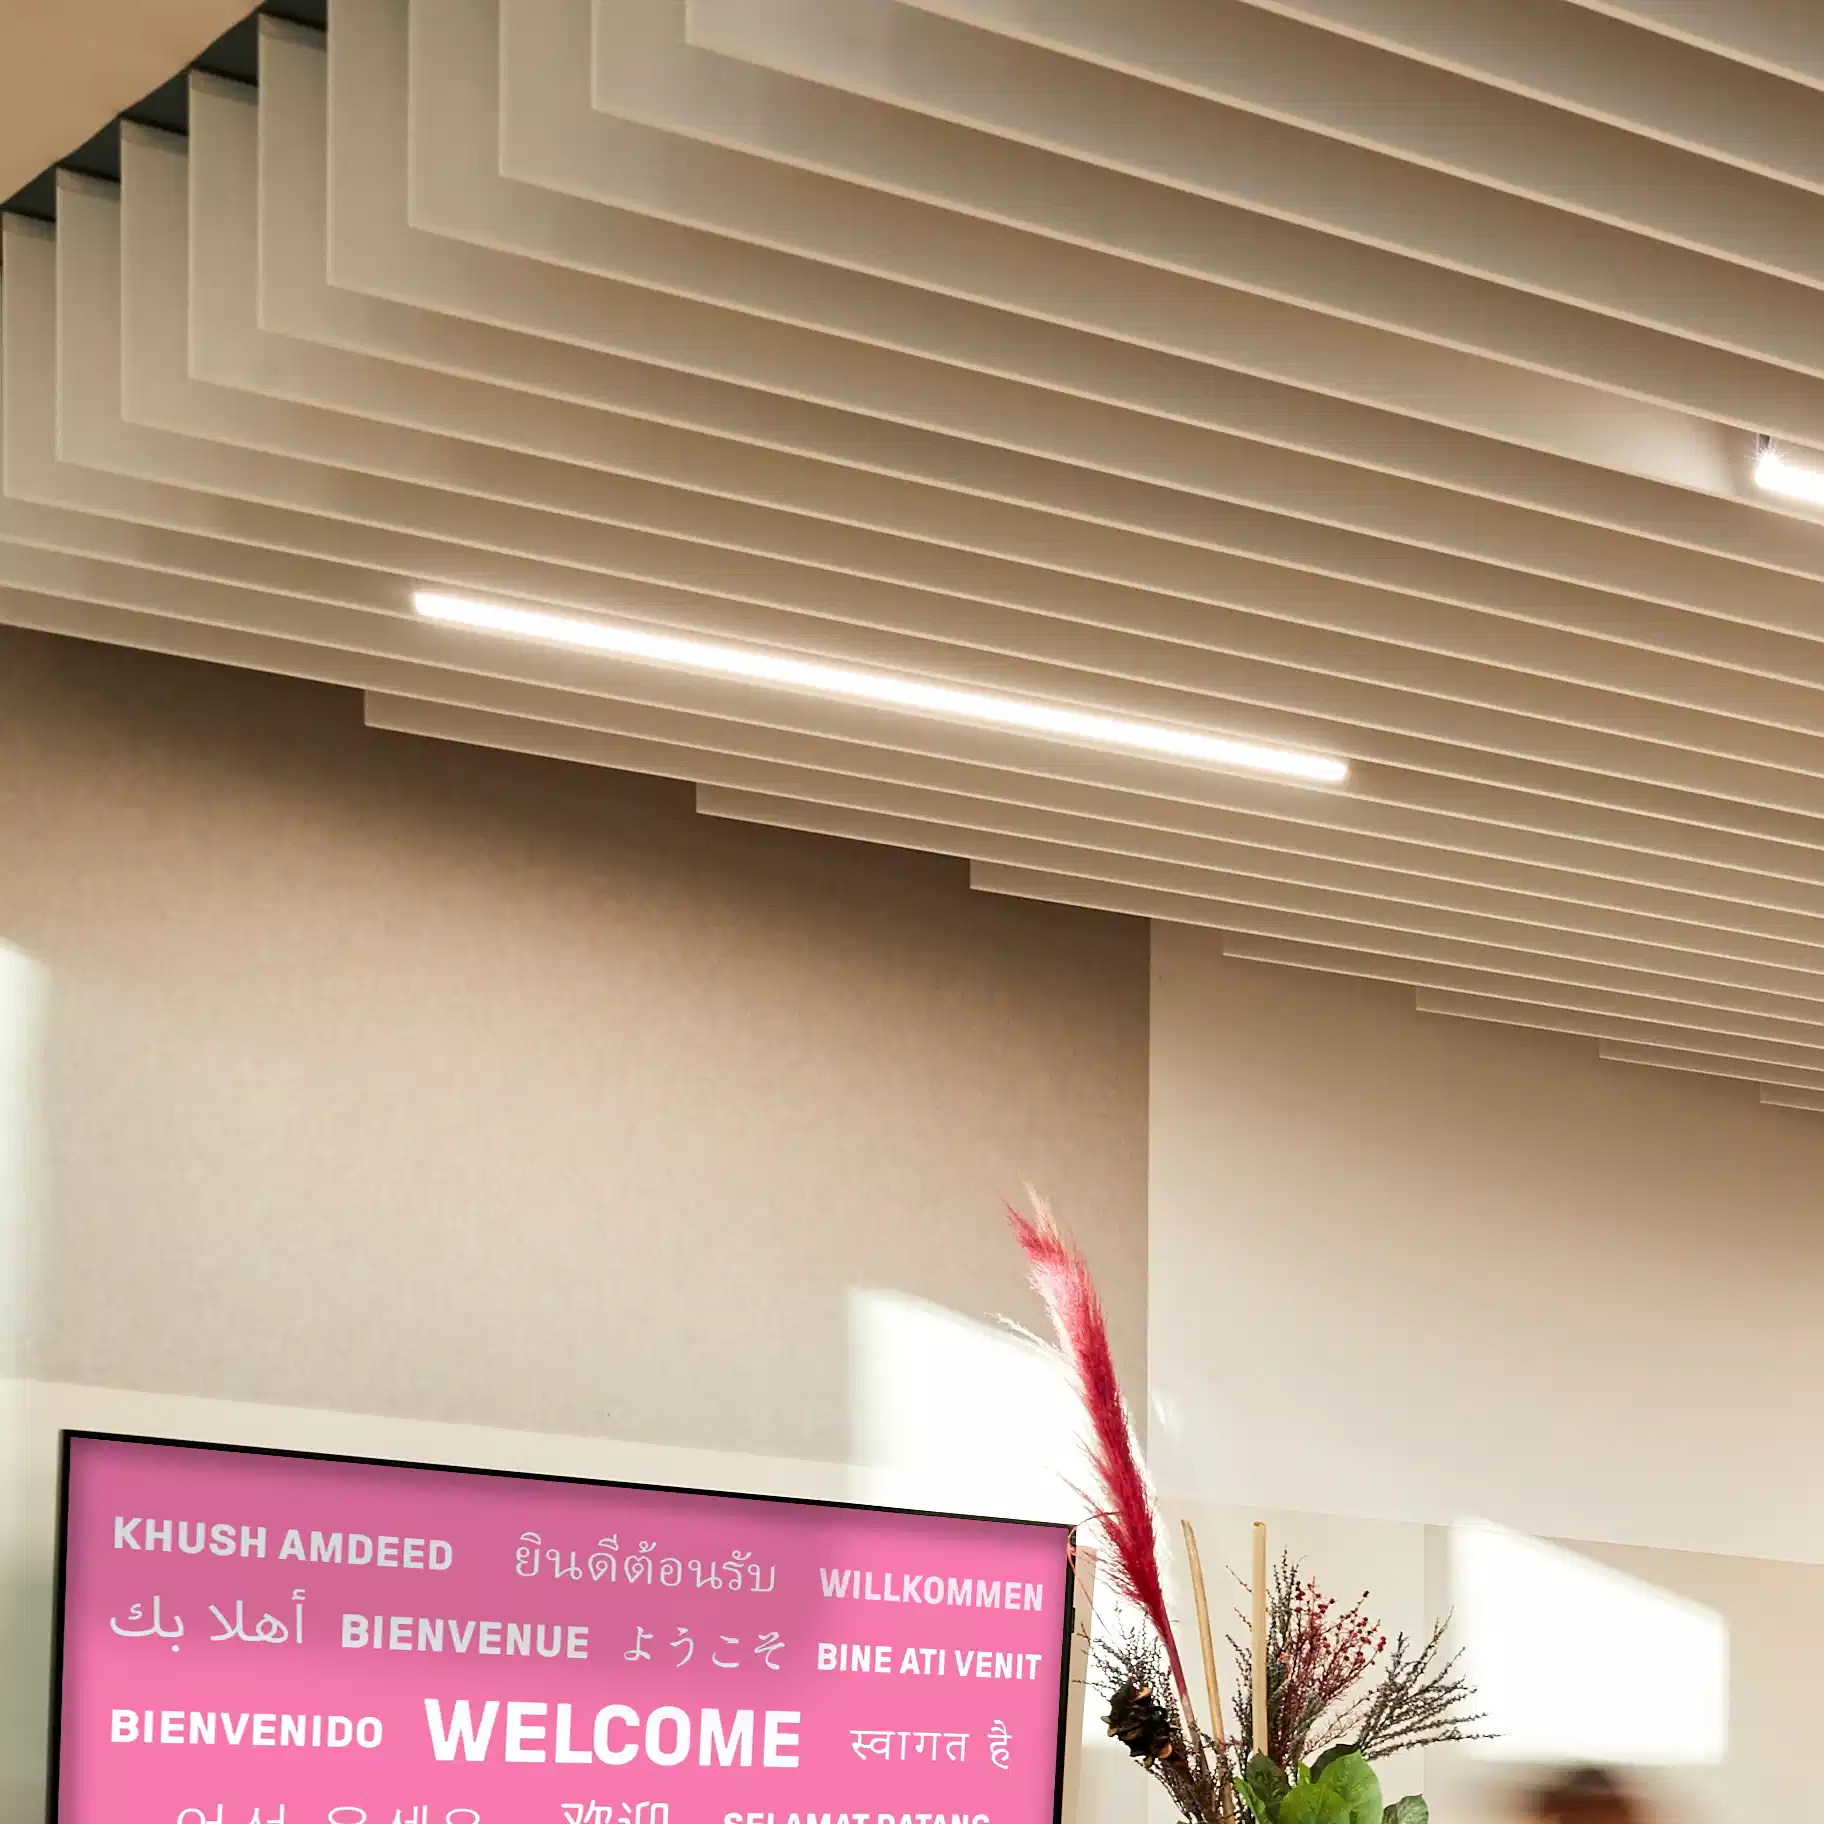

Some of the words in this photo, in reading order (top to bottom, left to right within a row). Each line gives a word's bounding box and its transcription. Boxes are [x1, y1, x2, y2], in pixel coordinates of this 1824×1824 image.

[114, 1516, 267, 1559] KHUSH
[278, 1528, 453, 1571] AMDEED
[515, 1531, 776, 1593] ยินดีต้อนรับ
[819, 1567, 1044, 1612] WILLKOMMEN
[109, 1595, 185, 1653] بك
[208, 1588, 306, 1644] أهلا
[341, 1613, 589, 1659] BIENVENUE
[623, 1625, 786, 1671] ようこそ
[817, 1642, 893, 1674] BINE
[899, 1647, 946, 1676] ATI
[954, 1649, 1042, 1680] VENIT
[110, 1708, 383, 1749] BIENVENIDO
[424, 1697, 801, 1768] WELCOME
[849, 1729, 970, 1762] स्वागत
[987, 1719, 1013, 1770] है
